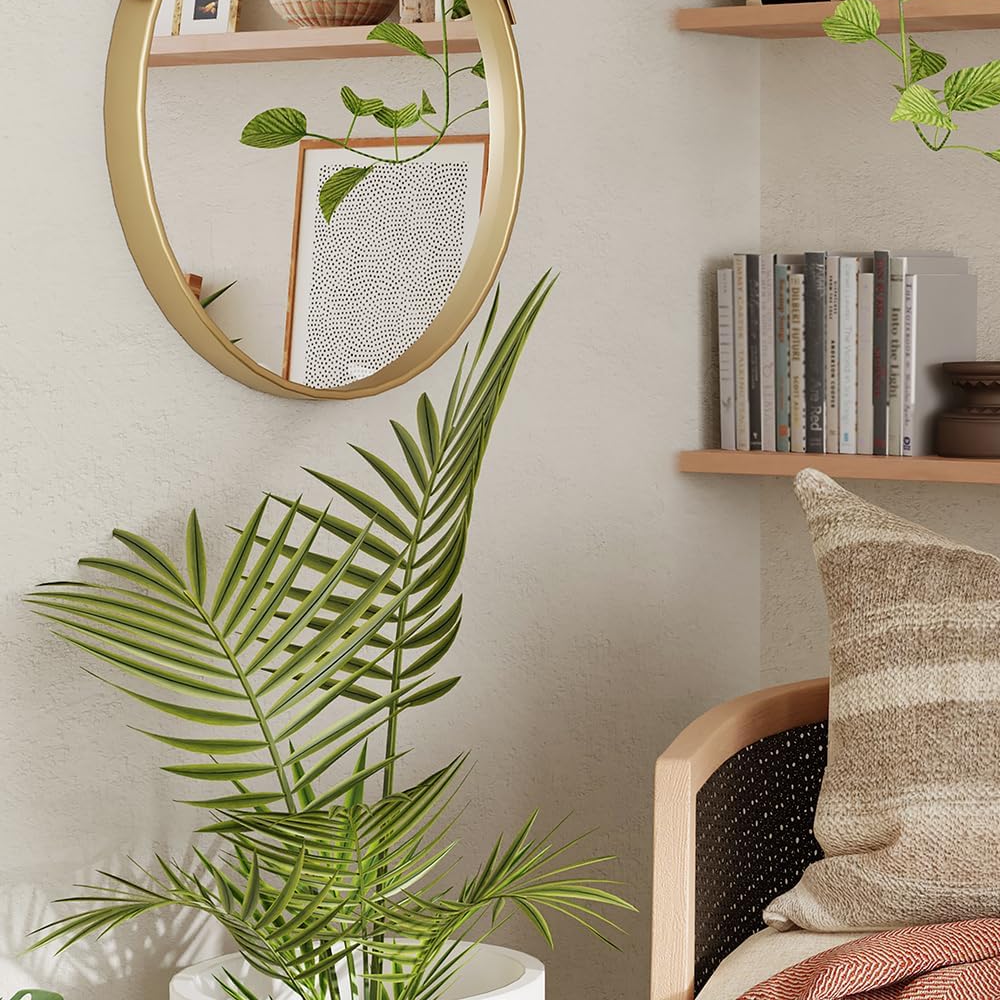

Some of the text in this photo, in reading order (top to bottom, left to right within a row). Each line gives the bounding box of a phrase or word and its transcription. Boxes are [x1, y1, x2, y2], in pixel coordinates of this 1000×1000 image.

[735, 258, 744, 291] JIMMY
[791, 286, 801, 324] DILBERT
[792, 327, 801, 361] FUTURE
[888, 307, 901, 399] Into the Light
[810, 405, 822, 431] Red
